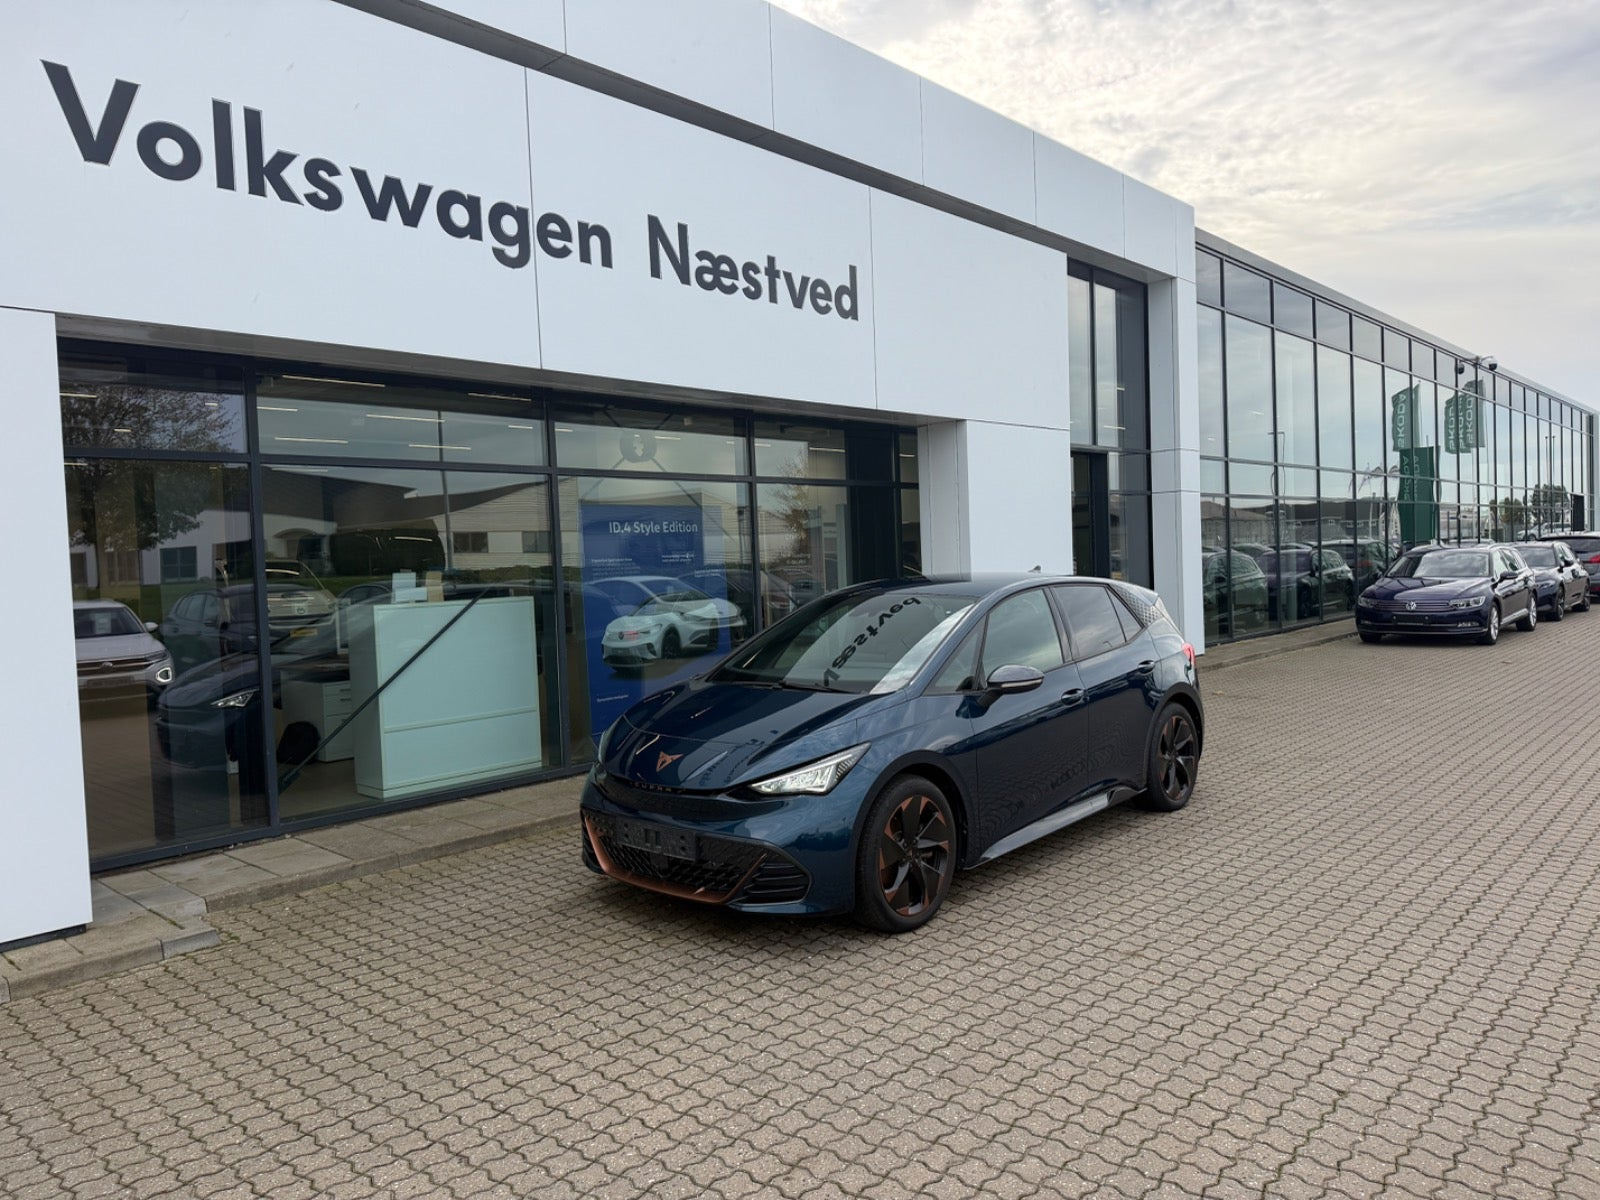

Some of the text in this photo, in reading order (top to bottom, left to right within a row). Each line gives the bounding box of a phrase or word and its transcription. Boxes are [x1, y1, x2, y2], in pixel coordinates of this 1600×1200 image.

[41, 59, 859, 321] Volkswagen Næstved
[608, 520, 698, 536] ID.4 Style Edition
